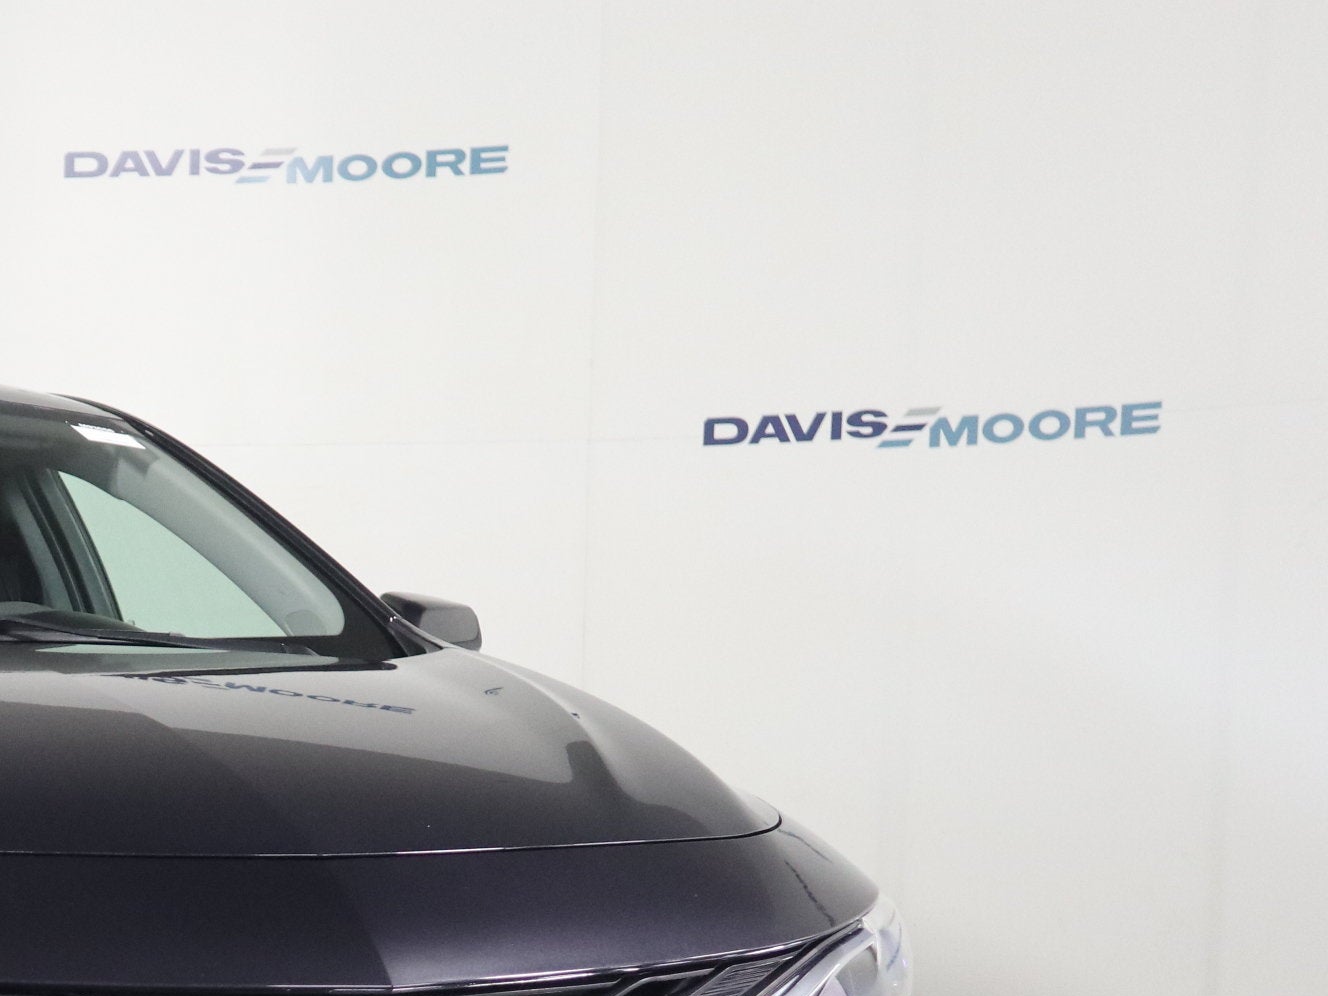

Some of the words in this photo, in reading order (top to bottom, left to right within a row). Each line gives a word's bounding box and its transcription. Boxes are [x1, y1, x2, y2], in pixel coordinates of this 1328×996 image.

[63, 147, 246, 178] DAVIS
[286, 145, 509, 184] MOORE
[703, 409, 888, 446] DAVIS
[929, 401, 1163, 448] MOORE
